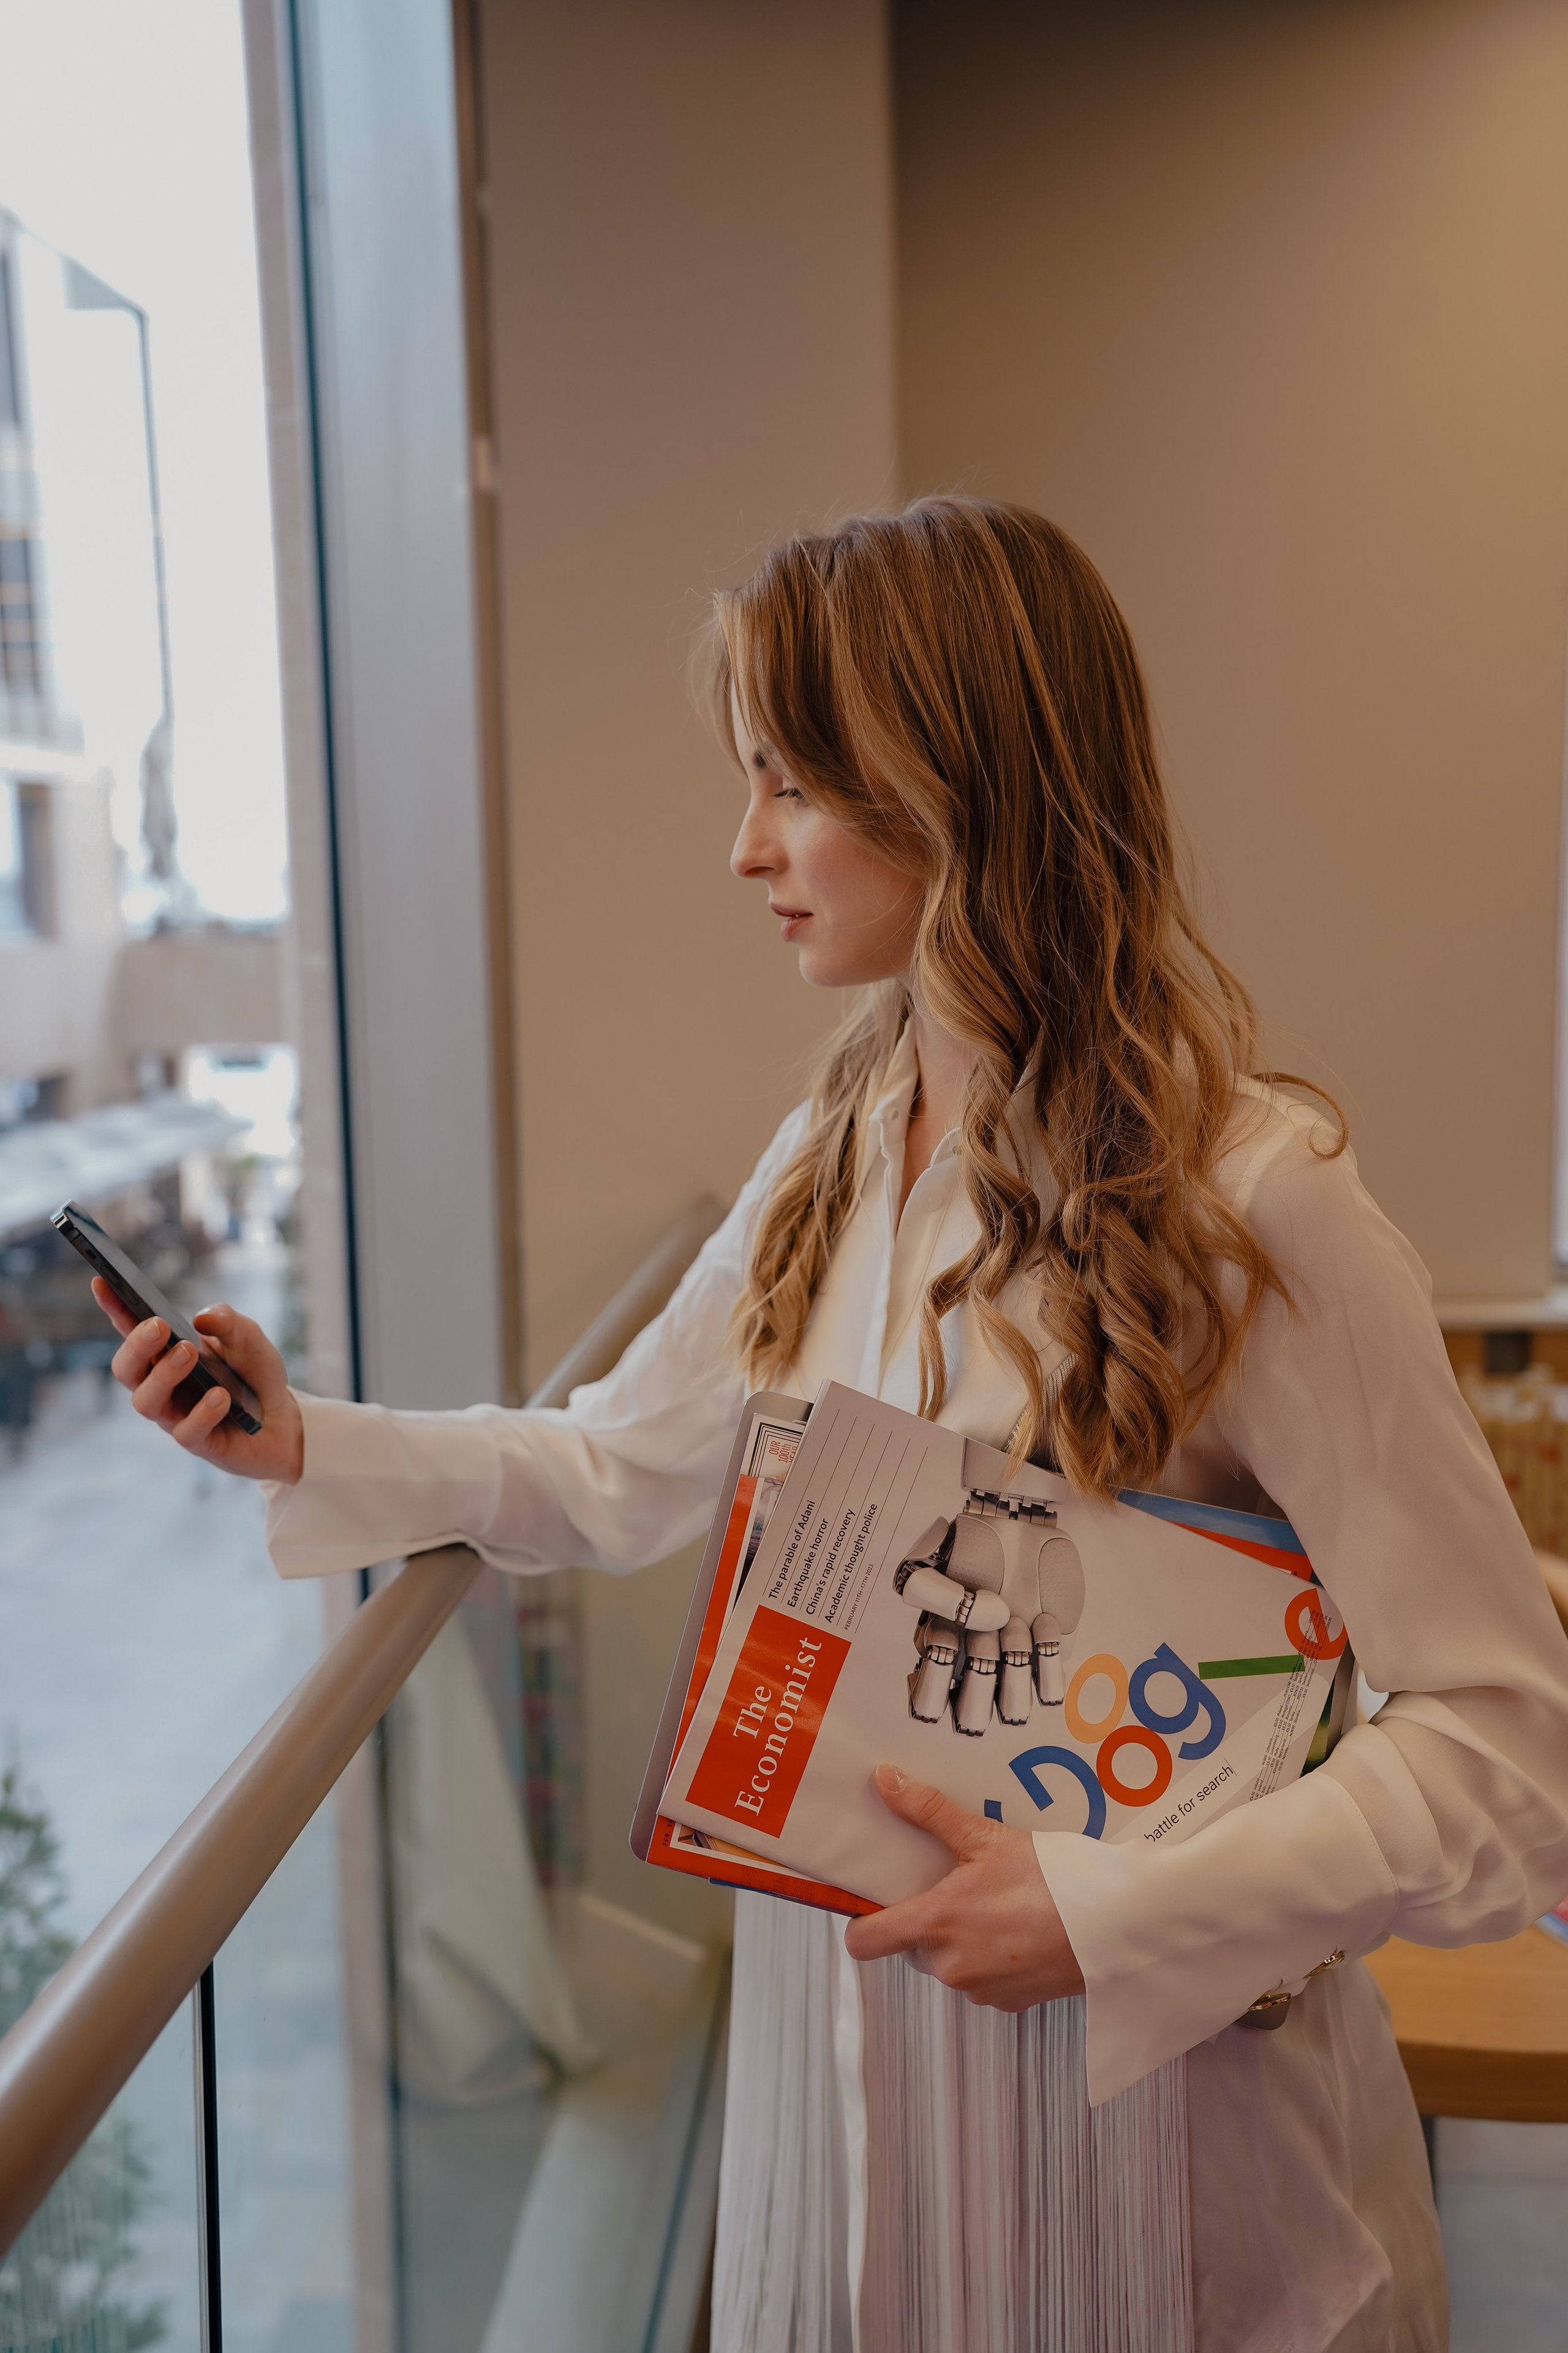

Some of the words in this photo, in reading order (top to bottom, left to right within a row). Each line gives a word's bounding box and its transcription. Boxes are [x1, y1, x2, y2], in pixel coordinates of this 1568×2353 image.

[769, 1440, 781, 1455] OUR
[778, 1444, 791, 1464] 100th
[798, 1500, 815, 1530] Adani
[795, 1529, 802, 1541] of
[822, 1552, 836, 1579] rapid
[833, 1509, 855, 1551] recovery
[779, 1543, 798, 1581] parable
[787, 1552, 816, 1607] Earthquake
[810, 1519, 828, 1550] horror
[825, 1574, 850, 1623] Academic
[844, 1534, 865, 1573] thought
[862, 1505, 877, 1534] police
[769, 1581, 783, 1598] The
[844, 1603, 858, 1630] FEBRUARY
[1305, 1668, 1314, 1687] Switzerland
[733, 1686, 771, 1739] The
[735, 1637, 821, 1816] Economist
[1269, 1734, 1279, 1754] Luxembourg
[1277, 1738, 1287, 1758] Netherlands
[1178, 1799, 1195, 1816] for
[1197, 1767, 1233, 1800] search
[662, 1830, 671, 1846] FEB.
